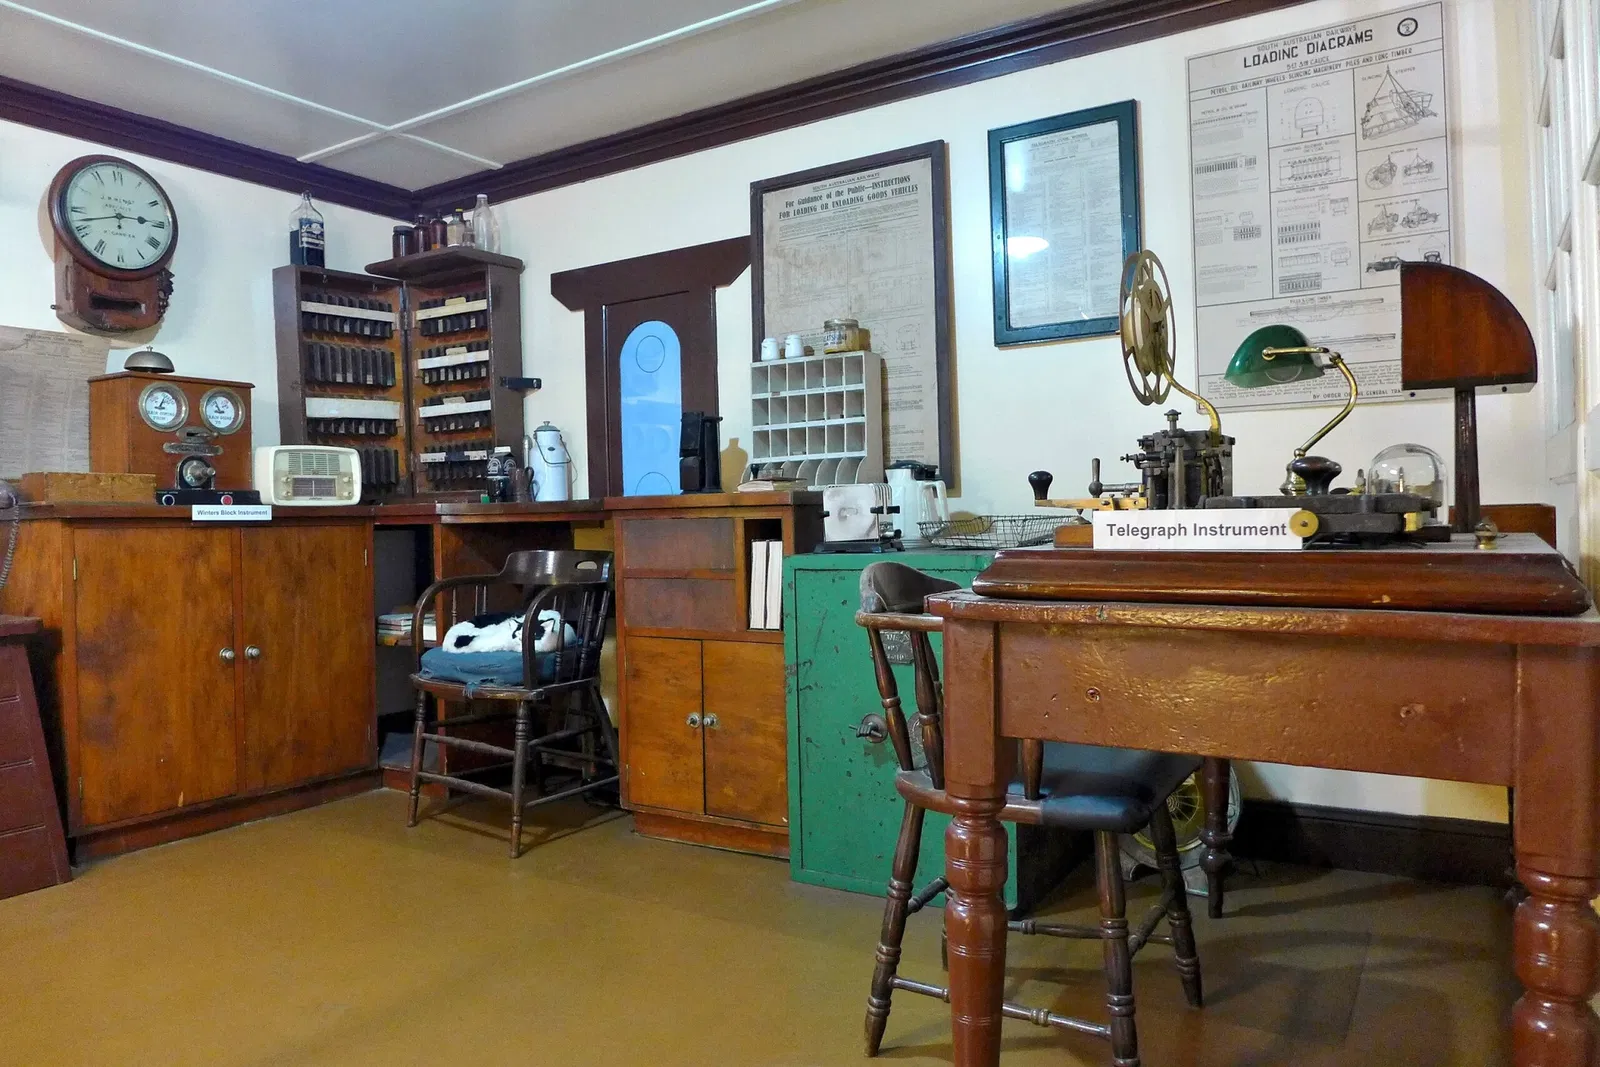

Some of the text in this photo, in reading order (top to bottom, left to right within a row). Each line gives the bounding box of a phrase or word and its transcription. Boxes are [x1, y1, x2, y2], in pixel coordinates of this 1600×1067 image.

[1257, 24, 1357, 52] SOUTH AUSTRALIAN RAILWAYS
[1265, 74, 1286, 84] WHEELS
[1313, 63, 1342, 73] MACHINERY
[1345, 58, 1360, 67] PILES
[1362, 55, 1373, 63] AND
[1391, 48, 1412, 57] TIMBER
[779, 211, 791, 220] FOR
[793, 205, 818, 217] LOADING
[820, 202, 829, 210] OR
[831, 195, 864, 209] UNLOADING
[867, 190, 888, 201] GOODS
[891, 184, 918, 197] VEHICLES
[785, 200, 795, 208] For
[797, 194, 823, 205] Guidance
[826, 192, 832, 200] of
[835, 189, 844, 198] the
[1106, 523, 1287, 539] Telegraph Instrument
